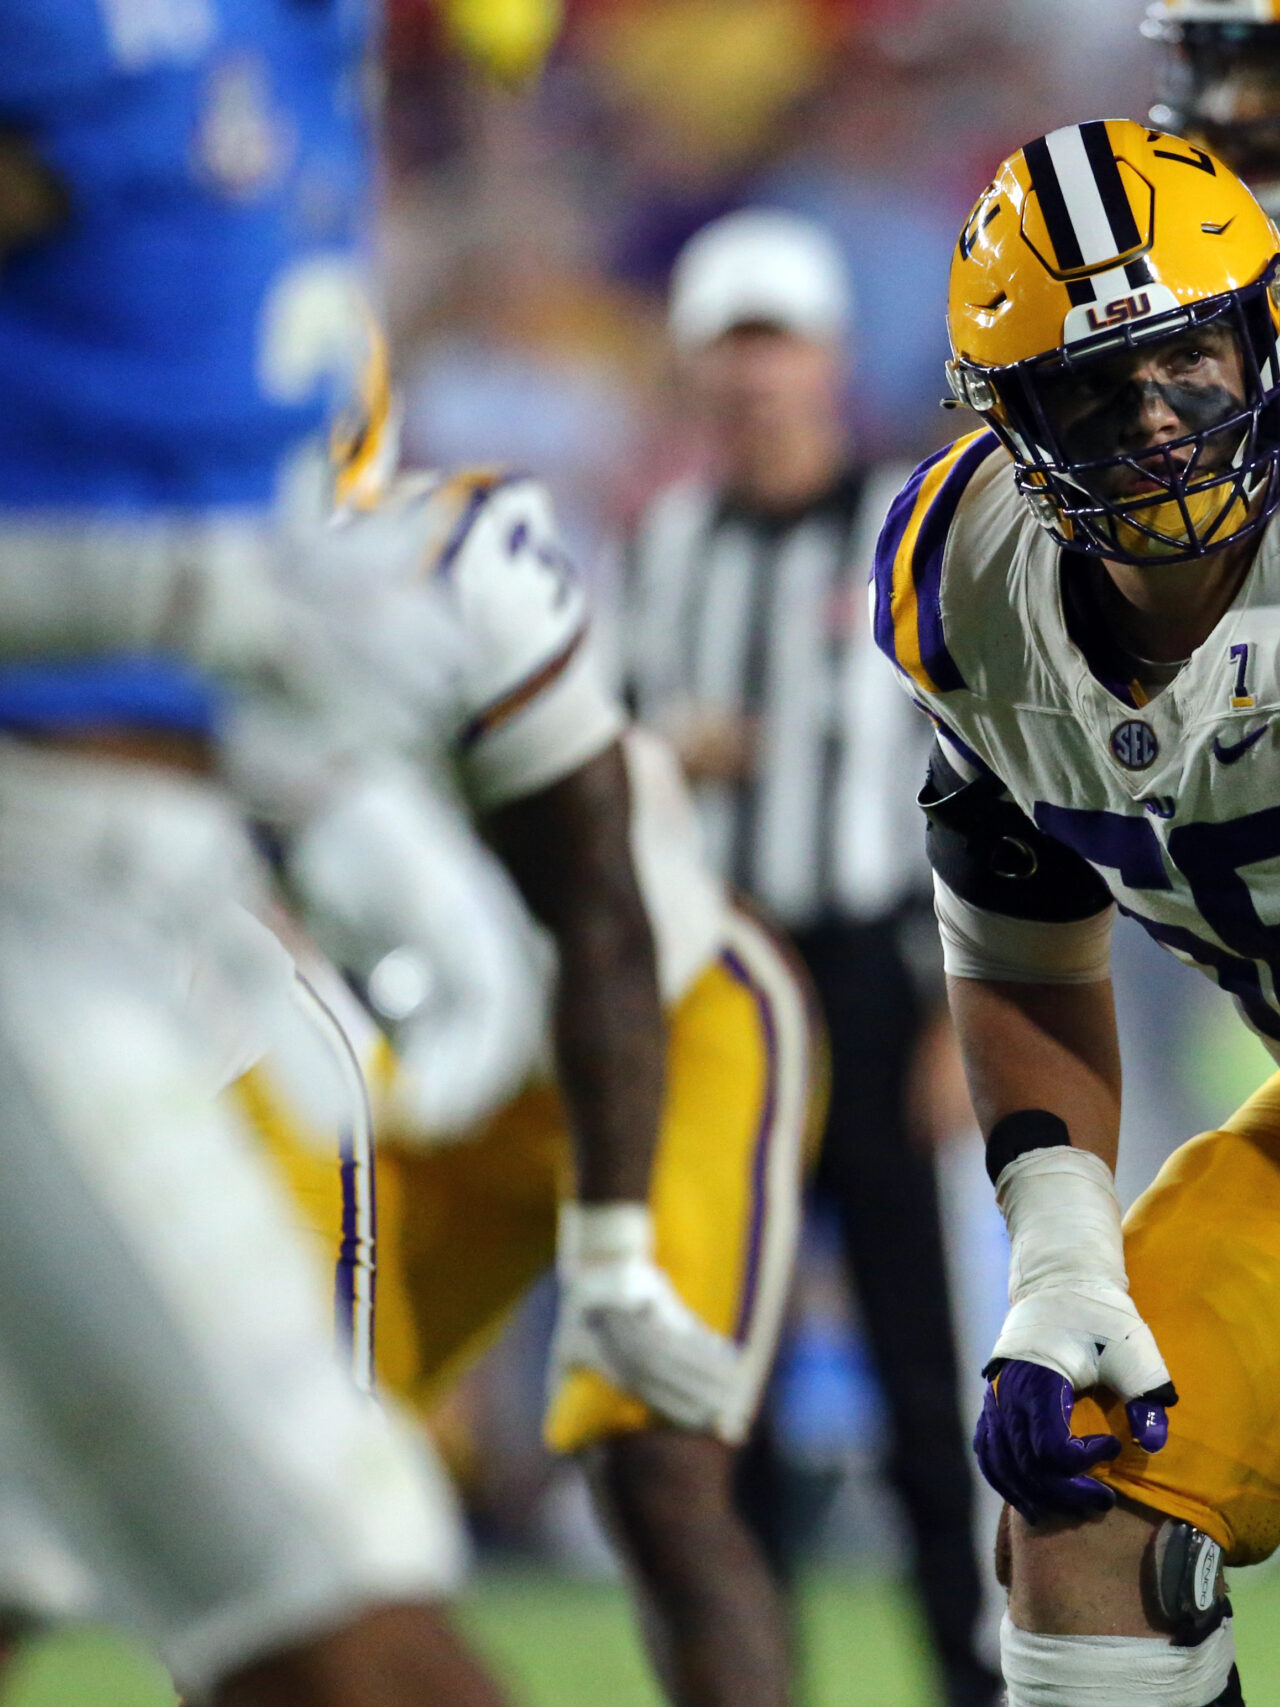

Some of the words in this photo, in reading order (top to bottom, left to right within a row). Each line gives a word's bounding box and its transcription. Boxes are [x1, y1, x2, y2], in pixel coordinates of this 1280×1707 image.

[1085, 292, 1152, 331] LSU
[1229, 643, 1254, 708] 7
[1115, 728, 1155, 767] SEC
